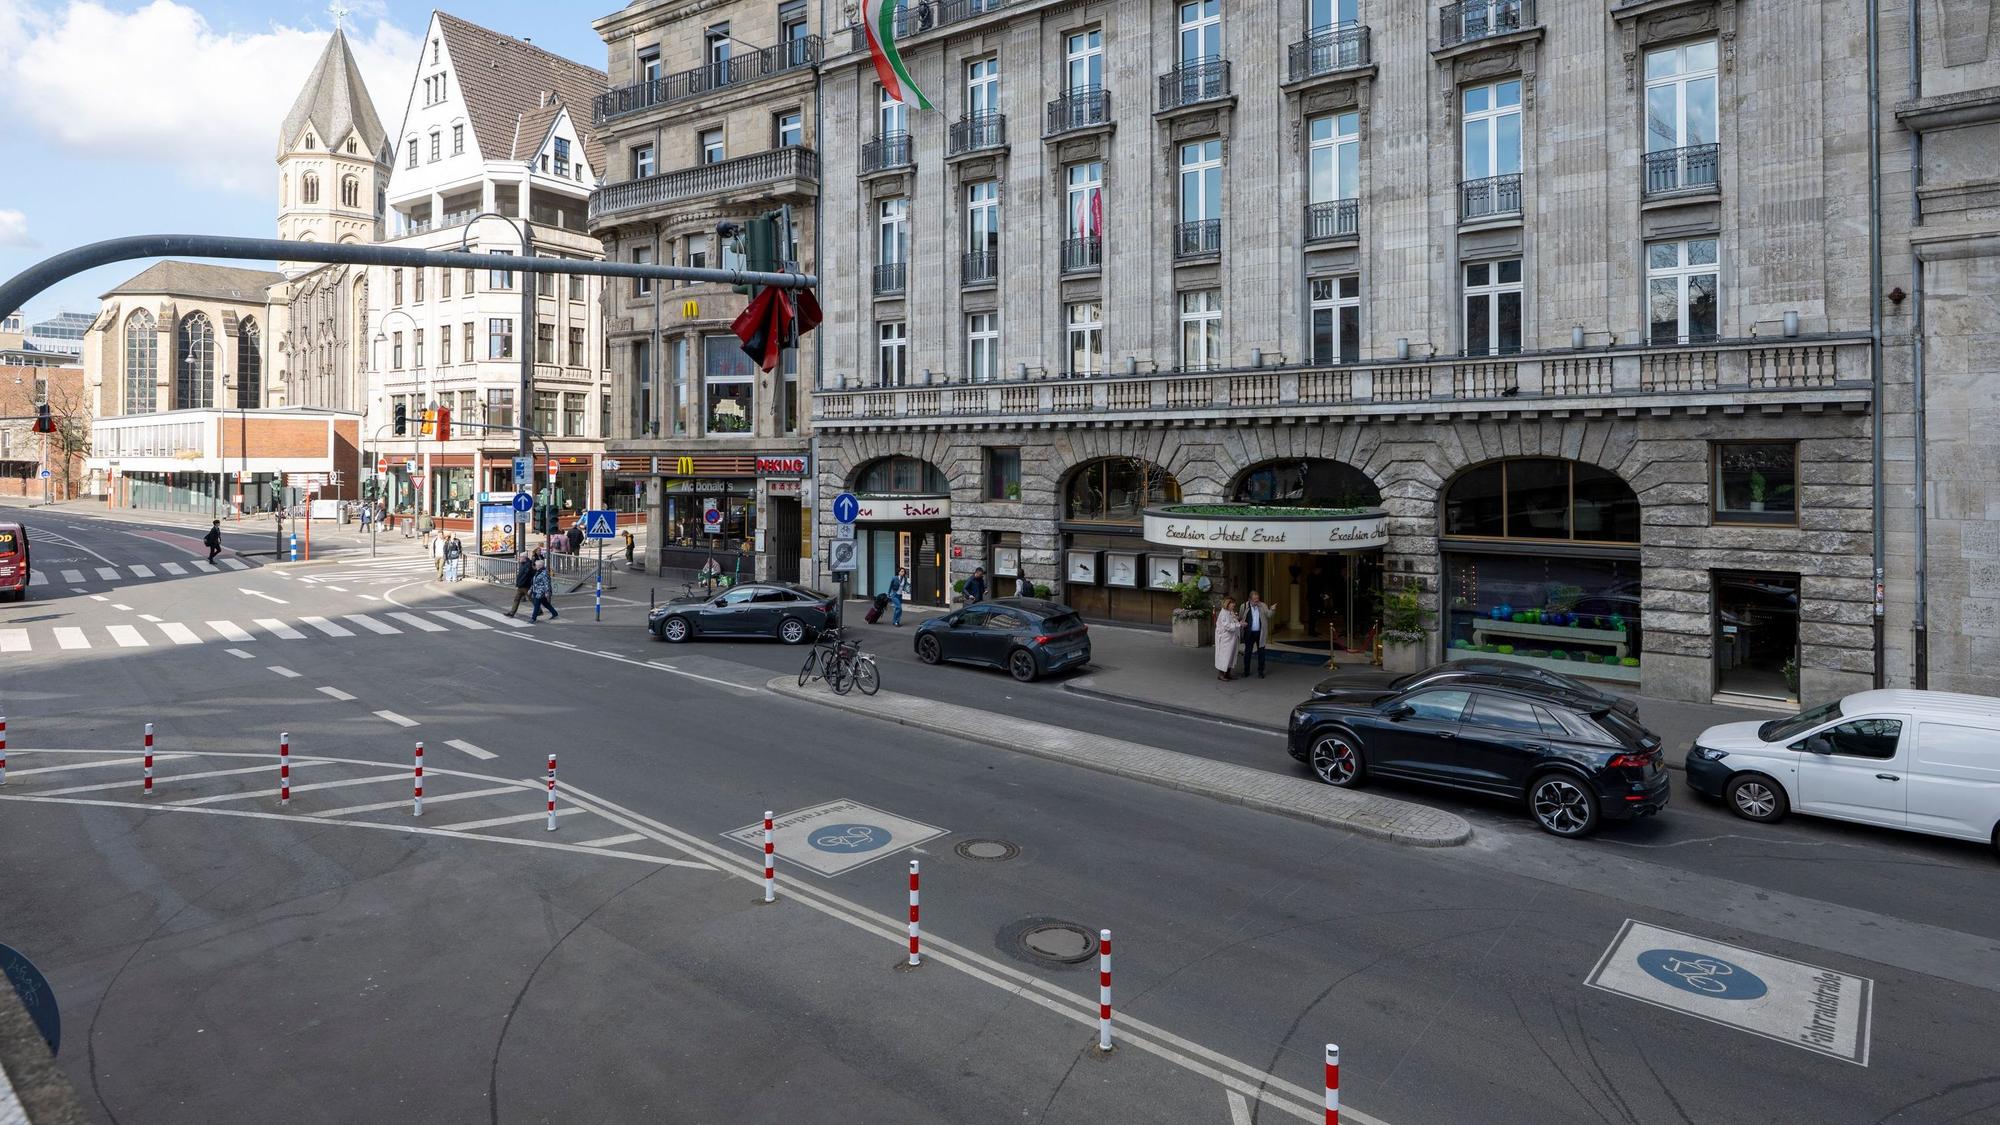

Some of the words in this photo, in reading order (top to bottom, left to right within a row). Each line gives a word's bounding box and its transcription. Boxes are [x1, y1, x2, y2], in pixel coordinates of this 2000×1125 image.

[757, 459, 804, 472] PEKING
[903, 503, 939, 516] taku
[1166, 524, 1205, 539] Excelsior
[1209, 524, 1248, 541] Hotel
[1251, 528, 1286, 543] Ernst
[1329, 525, 1369, 541] Excelsior
[1800, 972, 1842, 1050] Fahrradstraße
